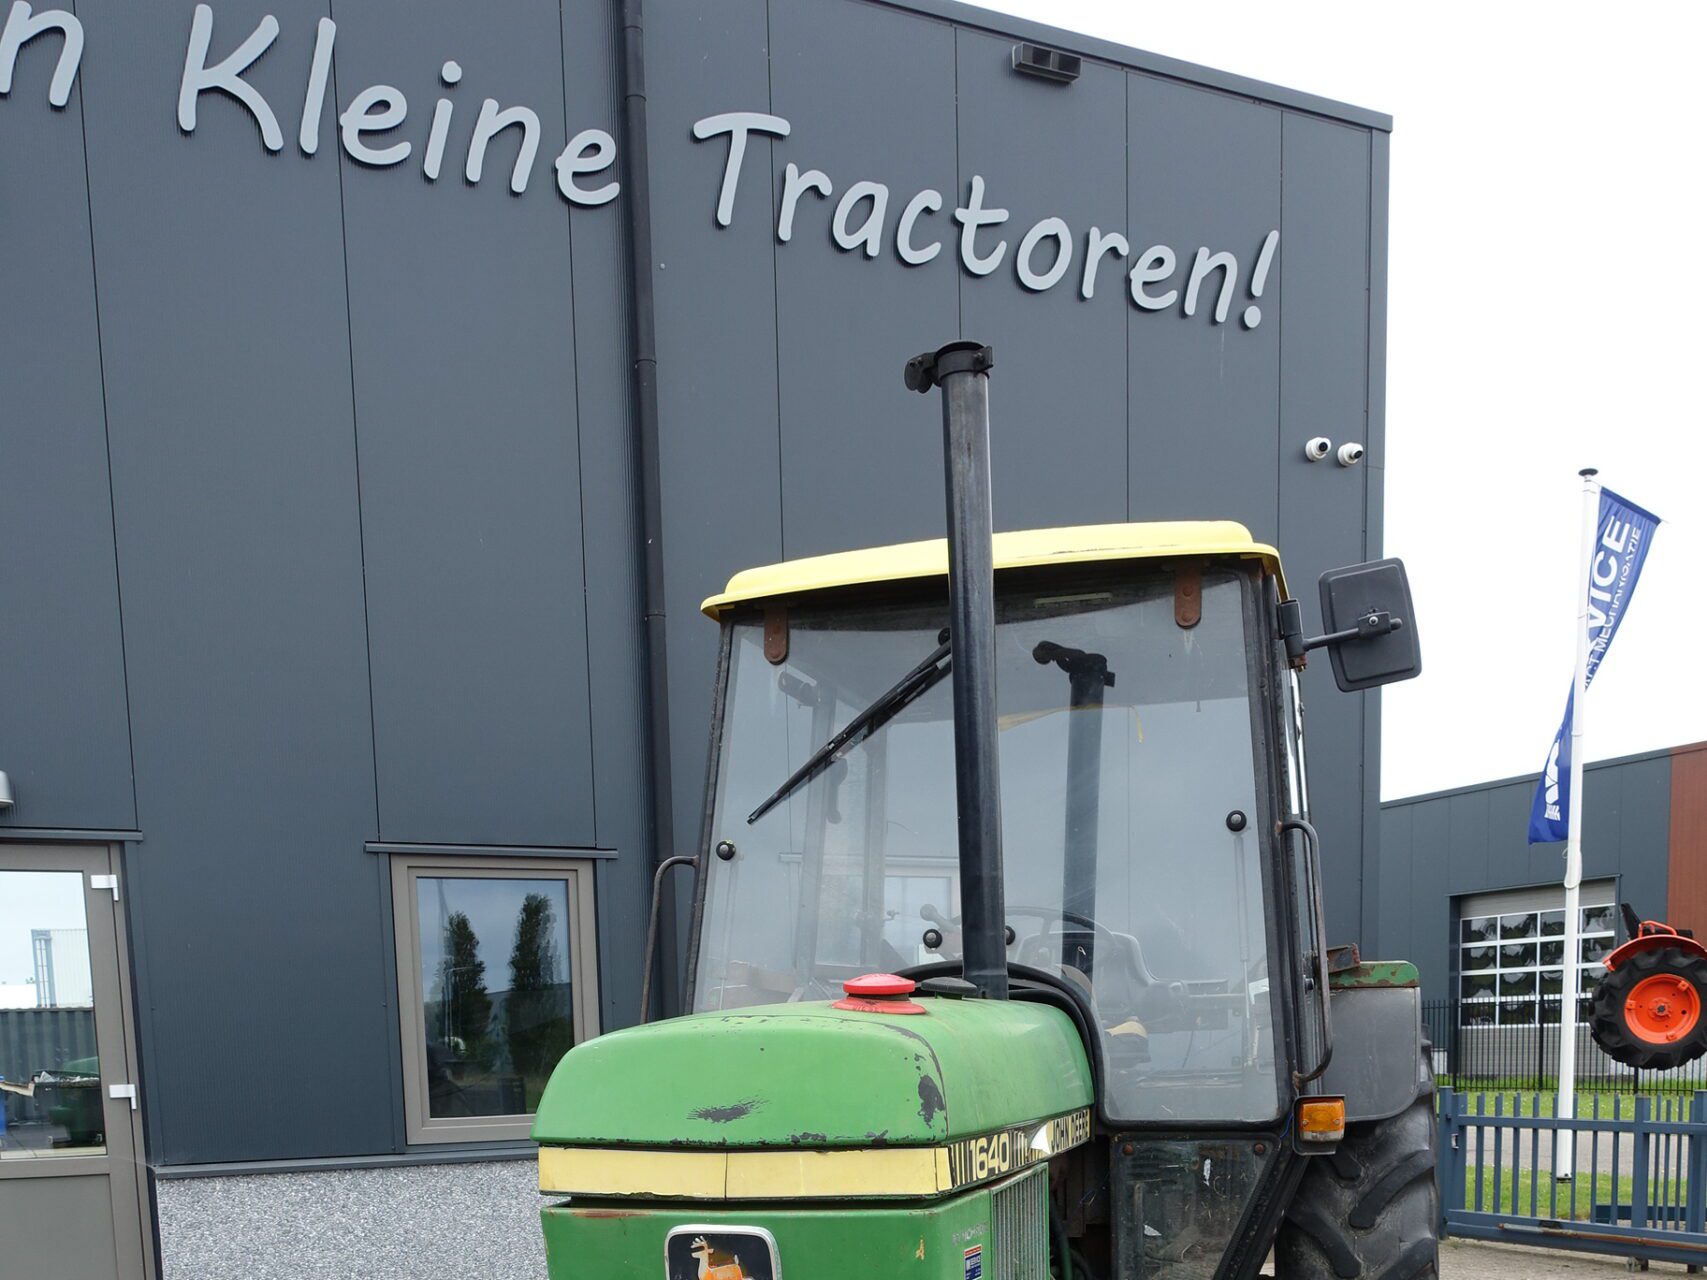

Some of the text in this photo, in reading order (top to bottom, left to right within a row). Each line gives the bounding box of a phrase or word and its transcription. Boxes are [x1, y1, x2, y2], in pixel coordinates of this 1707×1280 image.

[178, 4, 621, 205] Kleine
[693, 111, 1280, 329] Tractoren!
[1587, 515, 1631, 645] VICE
[969, 1132, 1010, 1181] 1640
[1051, 1109, 1089, 1153] JOHN DEERE
